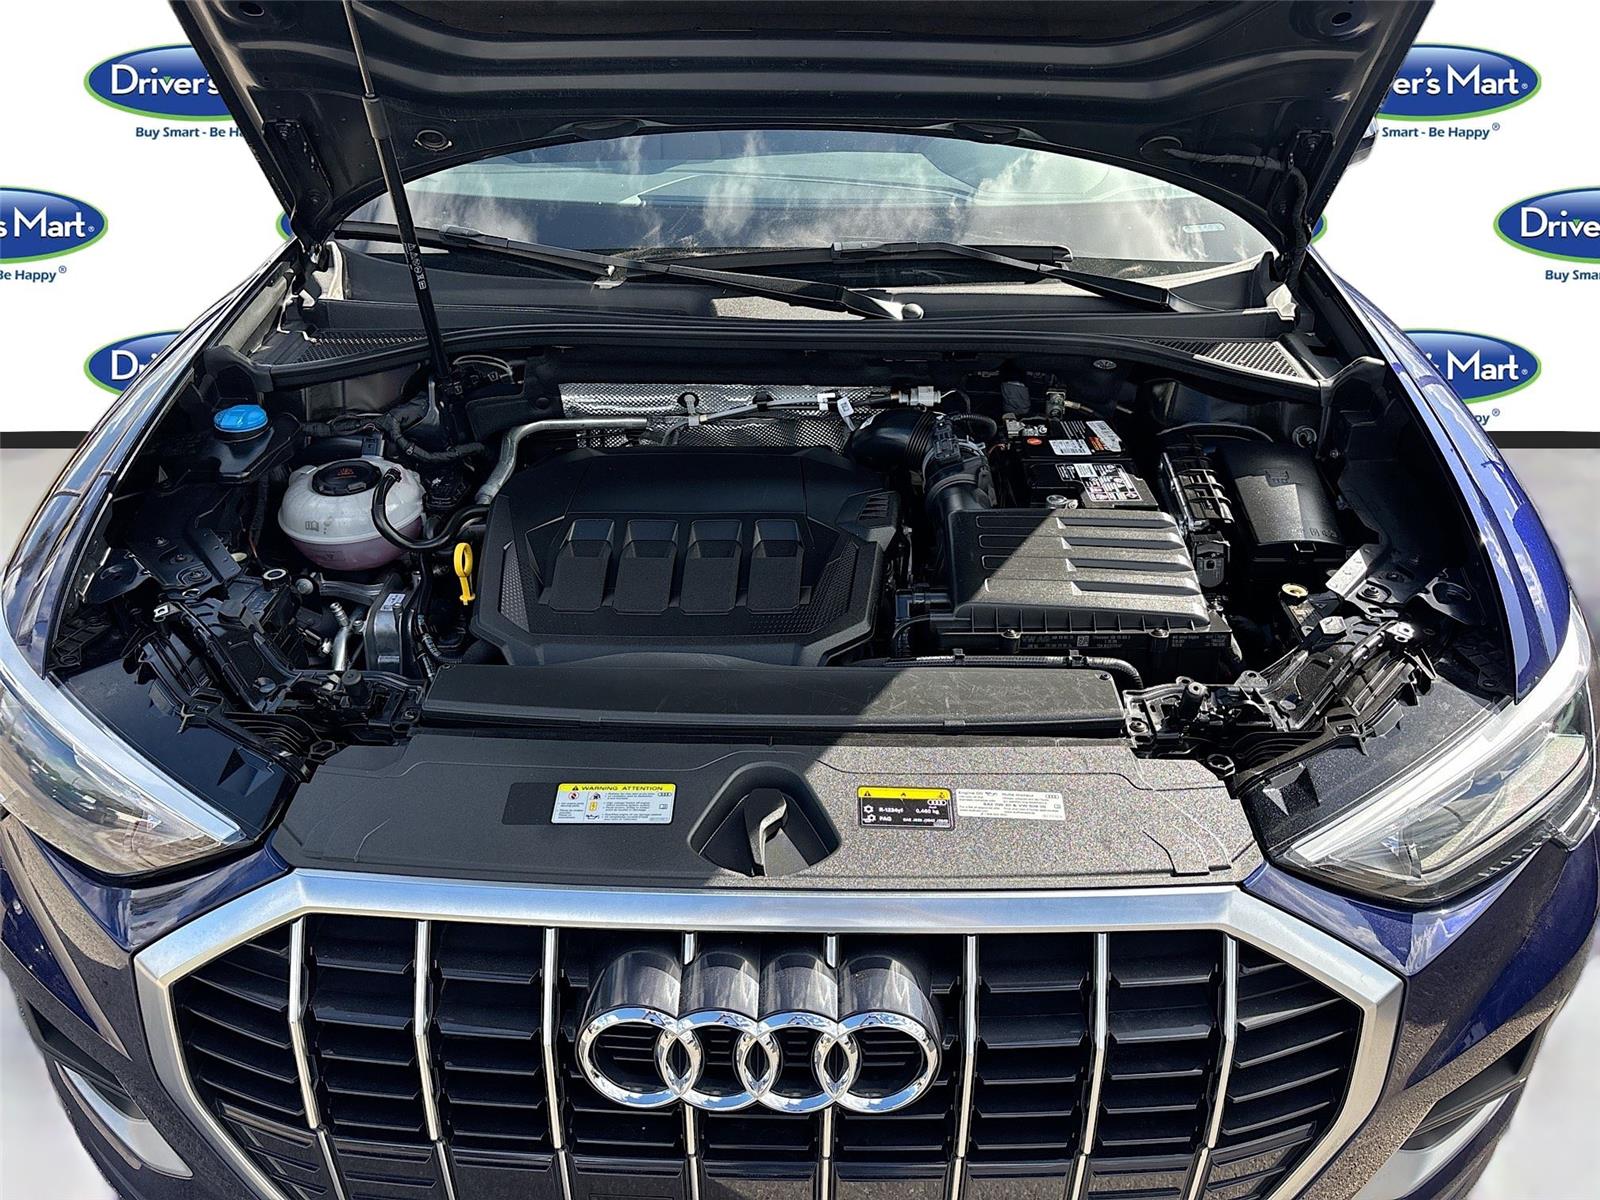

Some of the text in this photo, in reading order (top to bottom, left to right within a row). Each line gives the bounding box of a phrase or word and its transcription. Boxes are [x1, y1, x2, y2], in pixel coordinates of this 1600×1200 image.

[111, 63, 220, 95] Drivers
[1447, 63, 1519, 95] Mart
[136, 127, 160, 140] Buy
[163, 127, 200, 138] Smart
[210, 127, 226, 138] Be
[1382, 127, 1419, 138] Smart
[1429, 127, 1445, 138] Be
[1449, 127, 1490, 140] Happy
[14, 206, 86, 238] Mart
[1521, 206, 1600, 238] Drive
[15, 270, 57, 283] Happy
[1545, 270, 1570, 283] Buy
[1447, 349, 1519, 381] Mart
